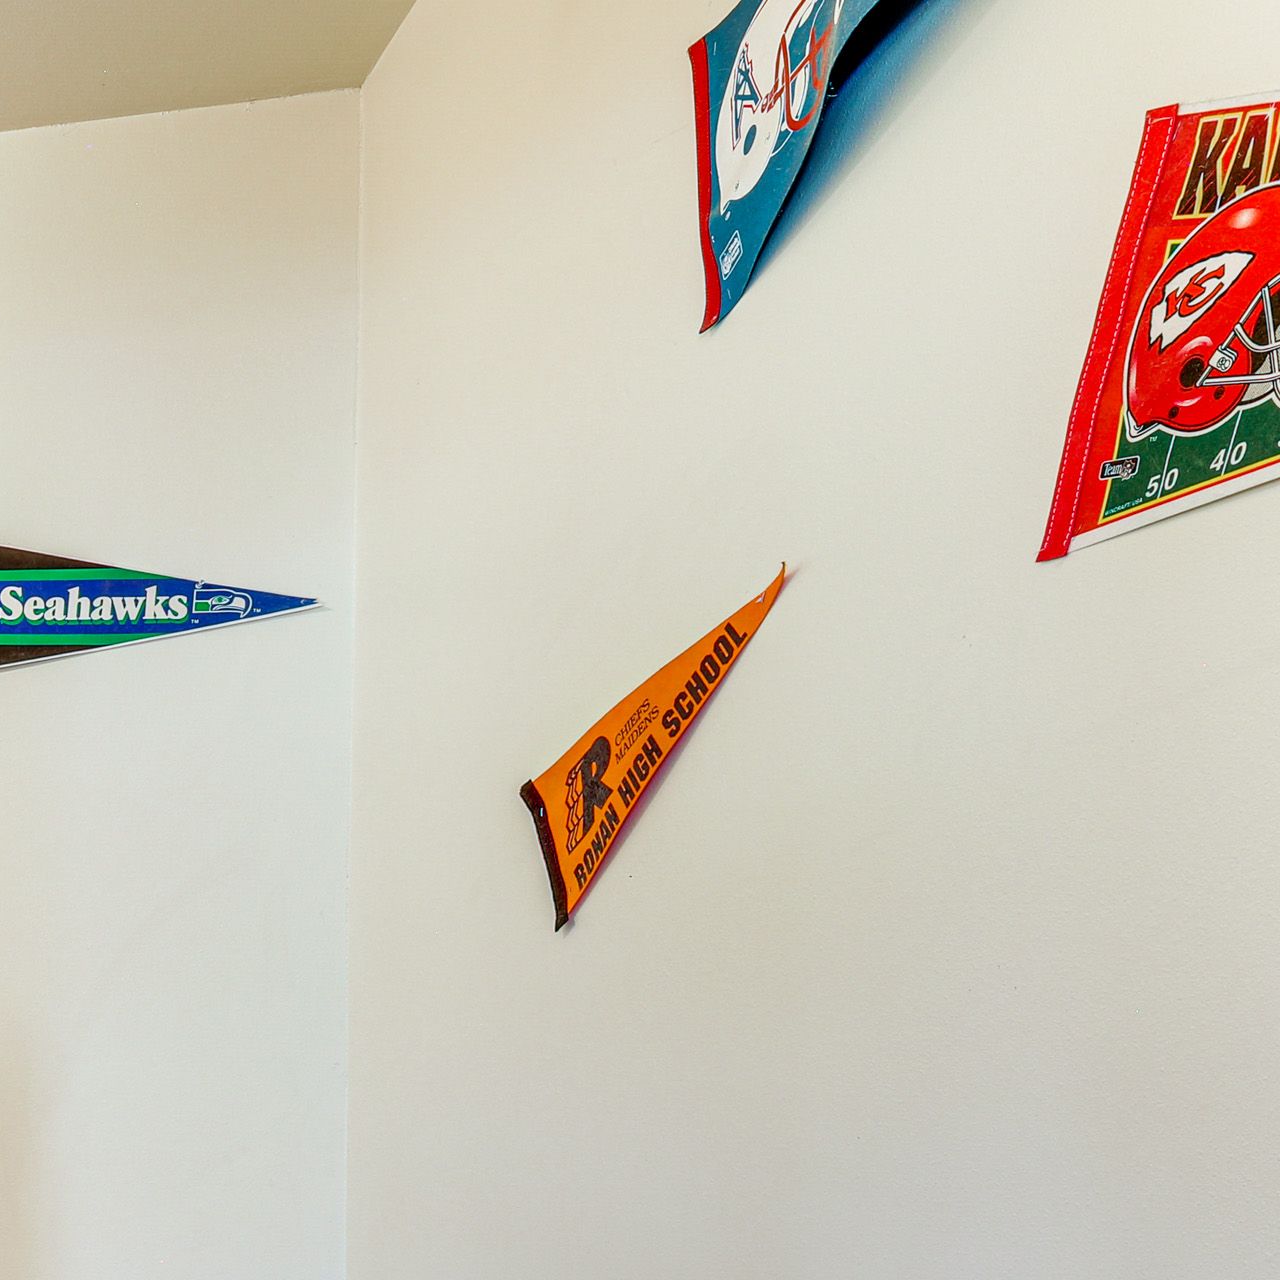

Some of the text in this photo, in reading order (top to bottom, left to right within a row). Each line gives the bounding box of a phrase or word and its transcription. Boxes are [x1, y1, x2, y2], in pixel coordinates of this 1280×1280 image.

[1145, 468, 1179, 497] 50
[1209, 441, 1247, 471] 40
[614, 698, 651, 747] CHIEFS
[615, 705, 660, 765] MAIDENS
[573, 621, 748, 891] RONAN HIGH SCHOOL
[565, 735, 614, 855] R
